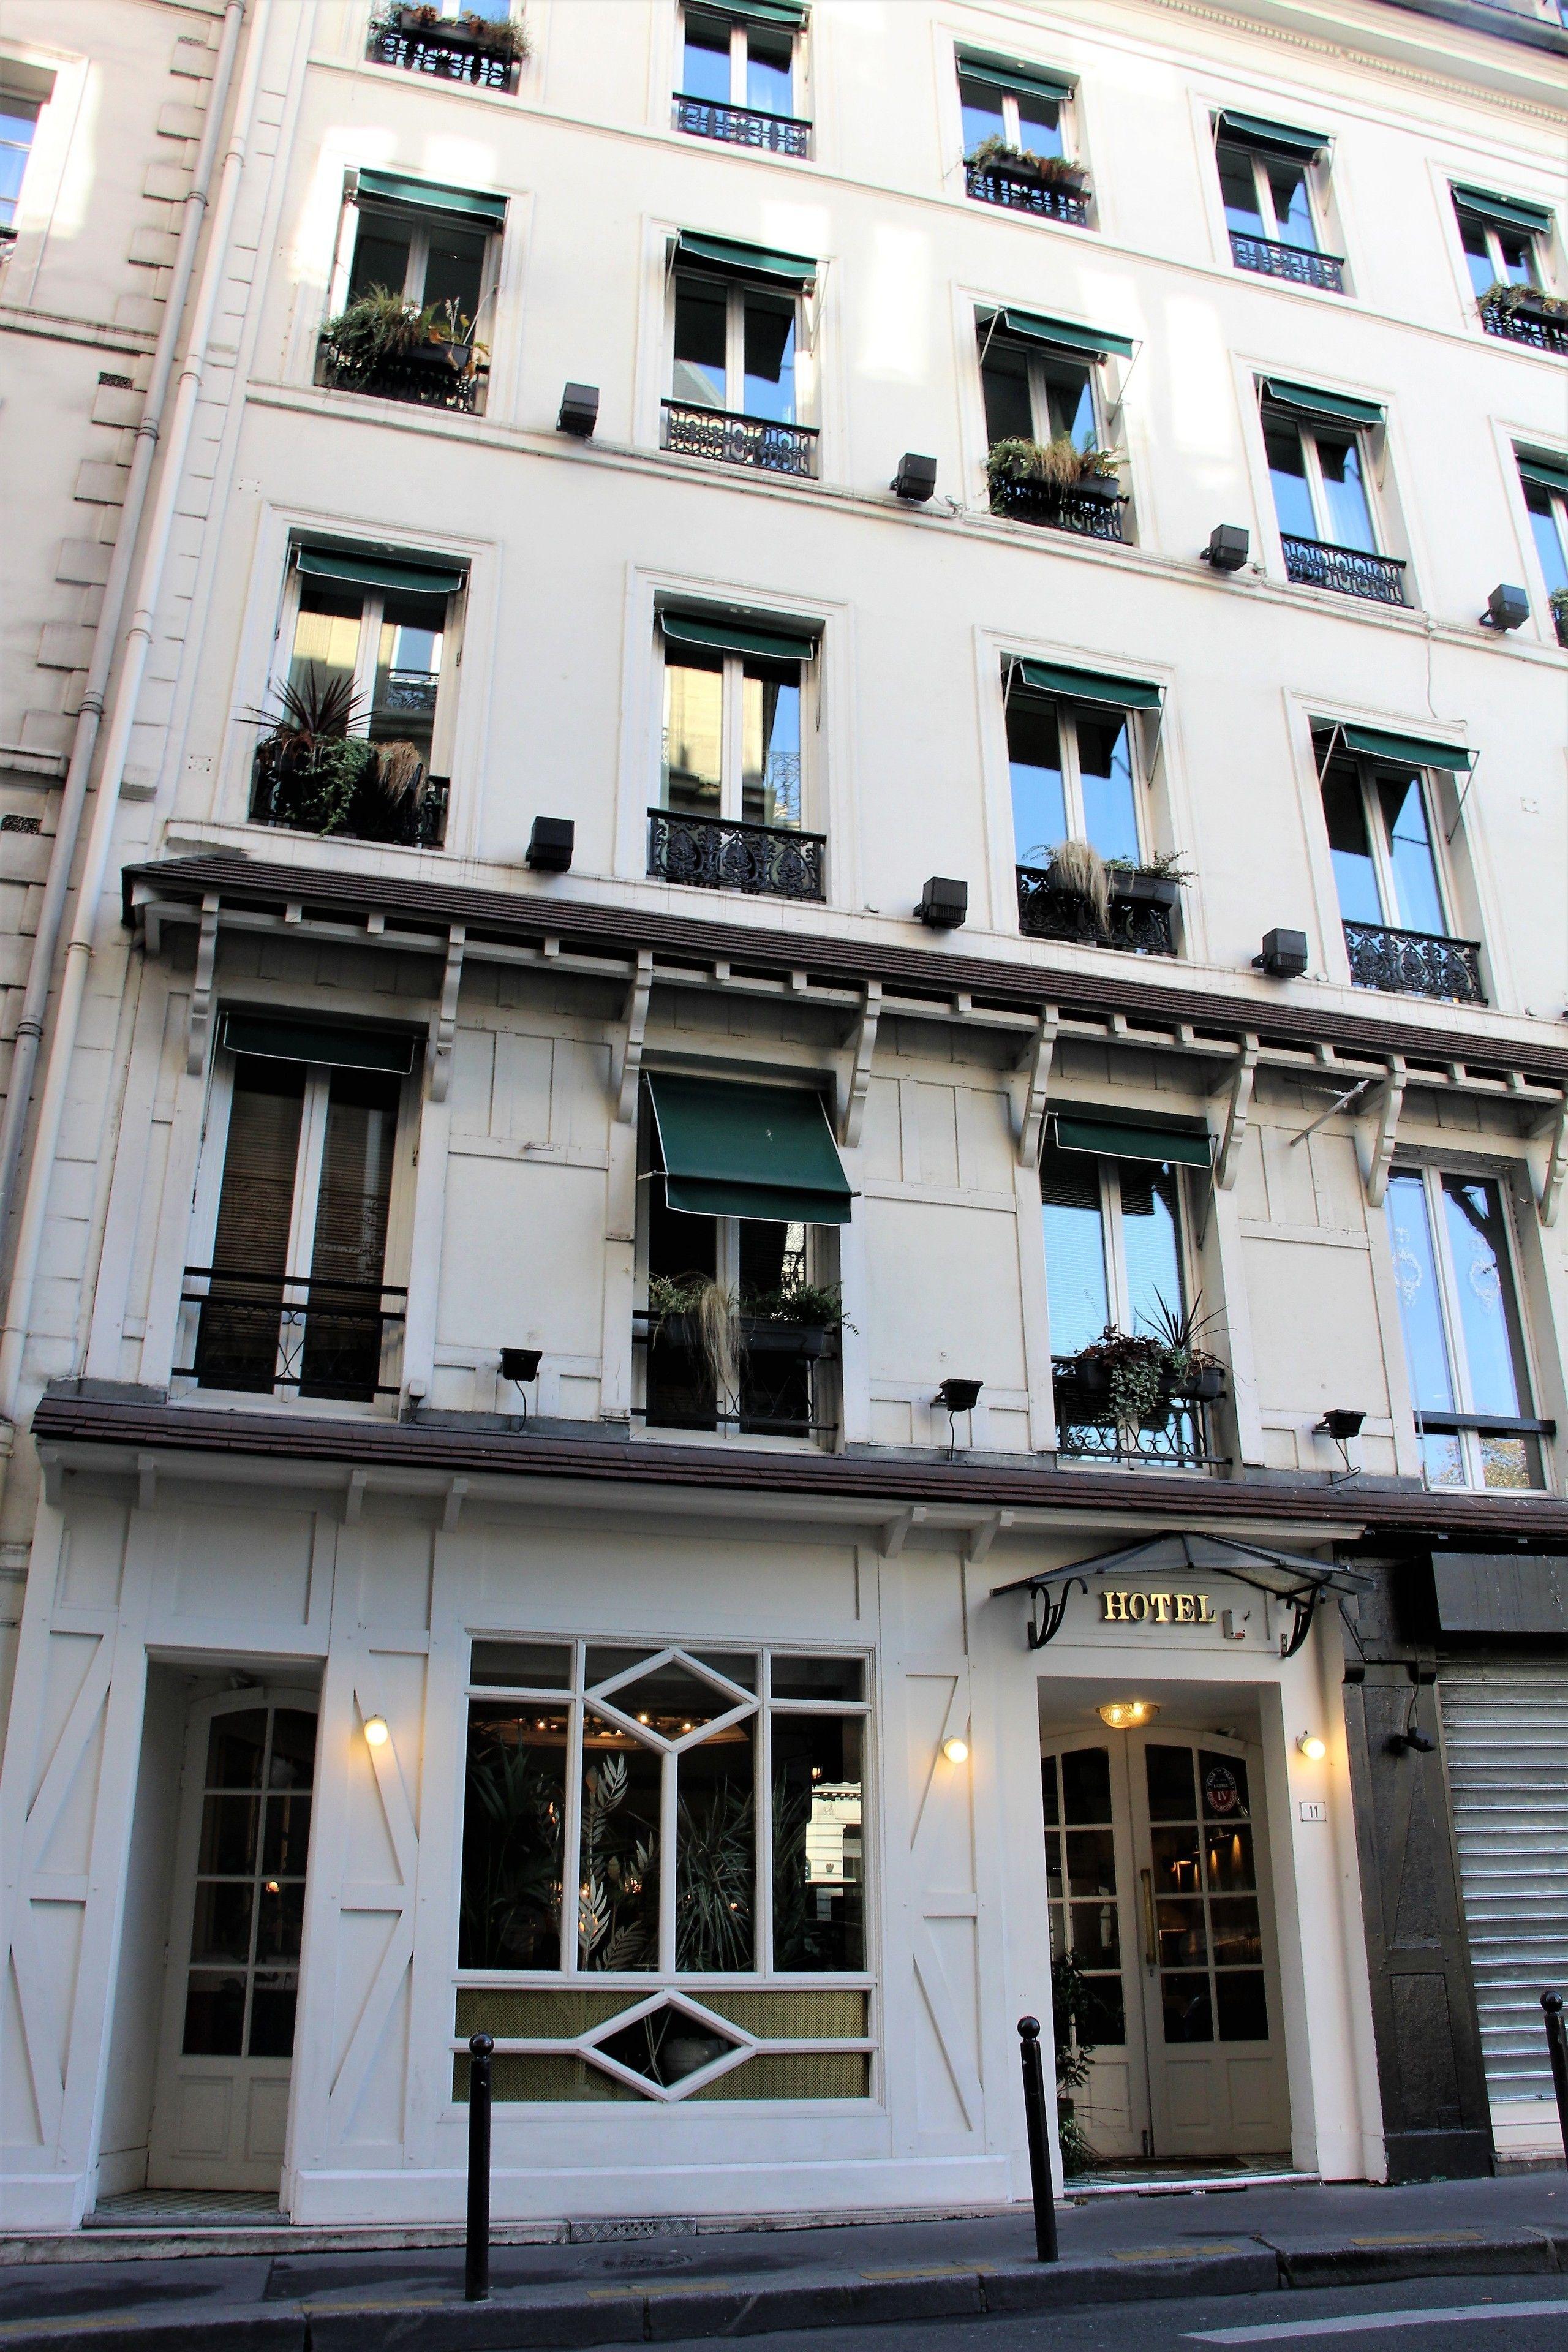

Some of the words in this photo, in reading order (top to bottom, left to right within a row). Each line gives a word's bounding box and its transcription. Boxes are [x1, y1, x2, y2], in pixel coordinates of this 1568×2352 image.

[1102, 1592, 1217, 1623] HOTEL
[1218, 1791, 1229, 1801] IV
[1309, 1805, 1318, 1818] 11
